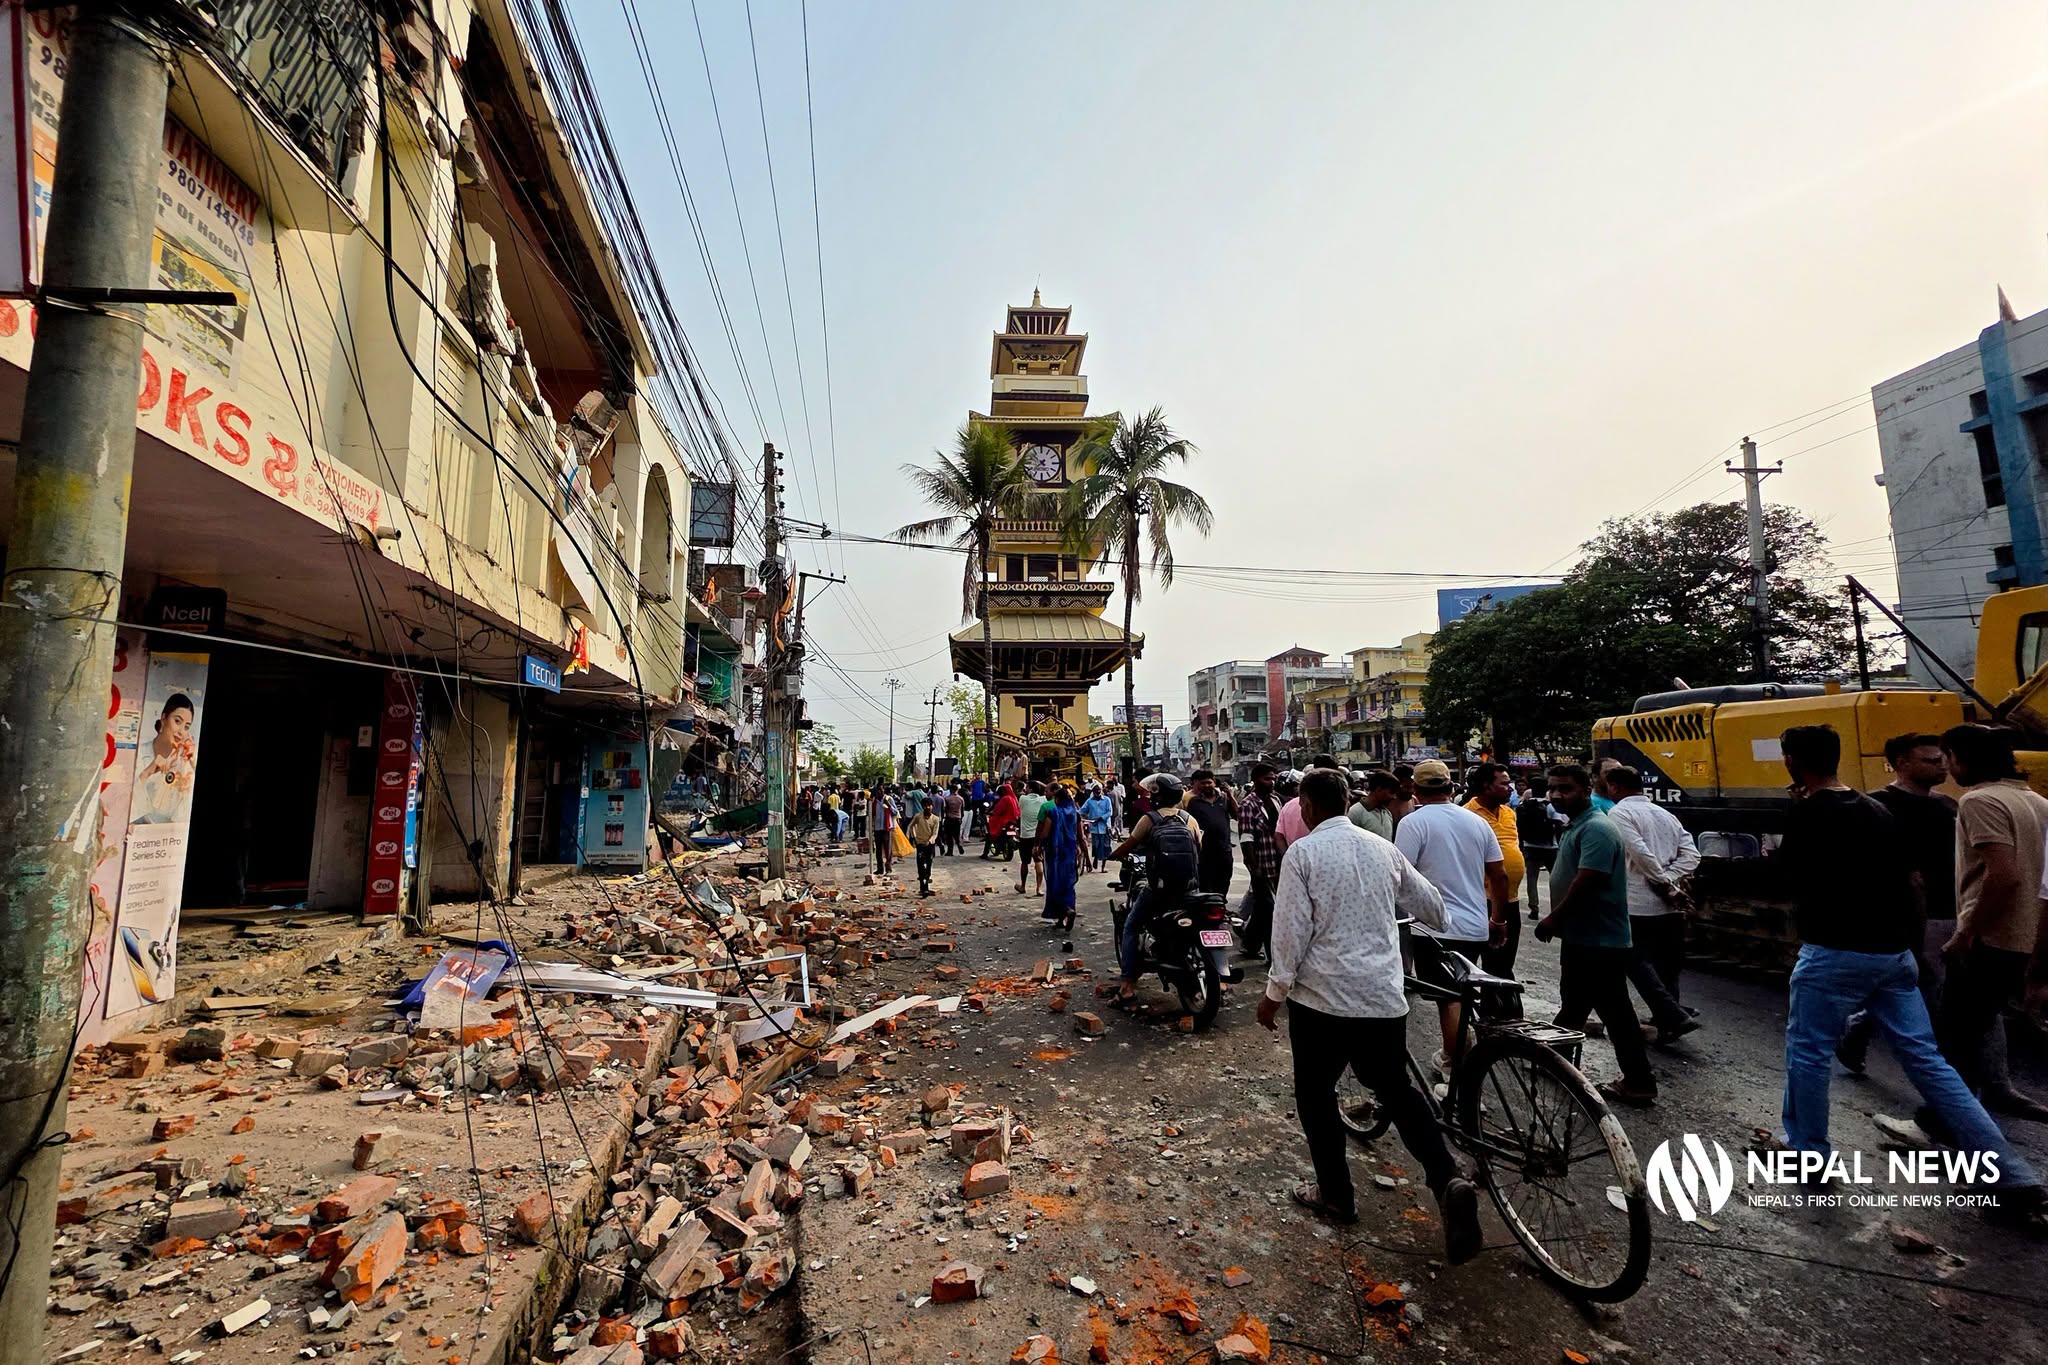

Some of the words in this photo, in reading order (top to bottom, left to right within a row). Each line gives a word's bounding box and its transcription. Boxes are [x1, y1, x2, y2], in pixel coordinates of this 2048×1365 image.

[197, 219, 240, 263] Hotel
[162, 604, 212, 622] Ncell
[530, 663, 557, 687] TECNO
[133, 840, 161, 849] realme
[169, 837, 182, 846] Pro
[132, 851, 154, 861] Series
